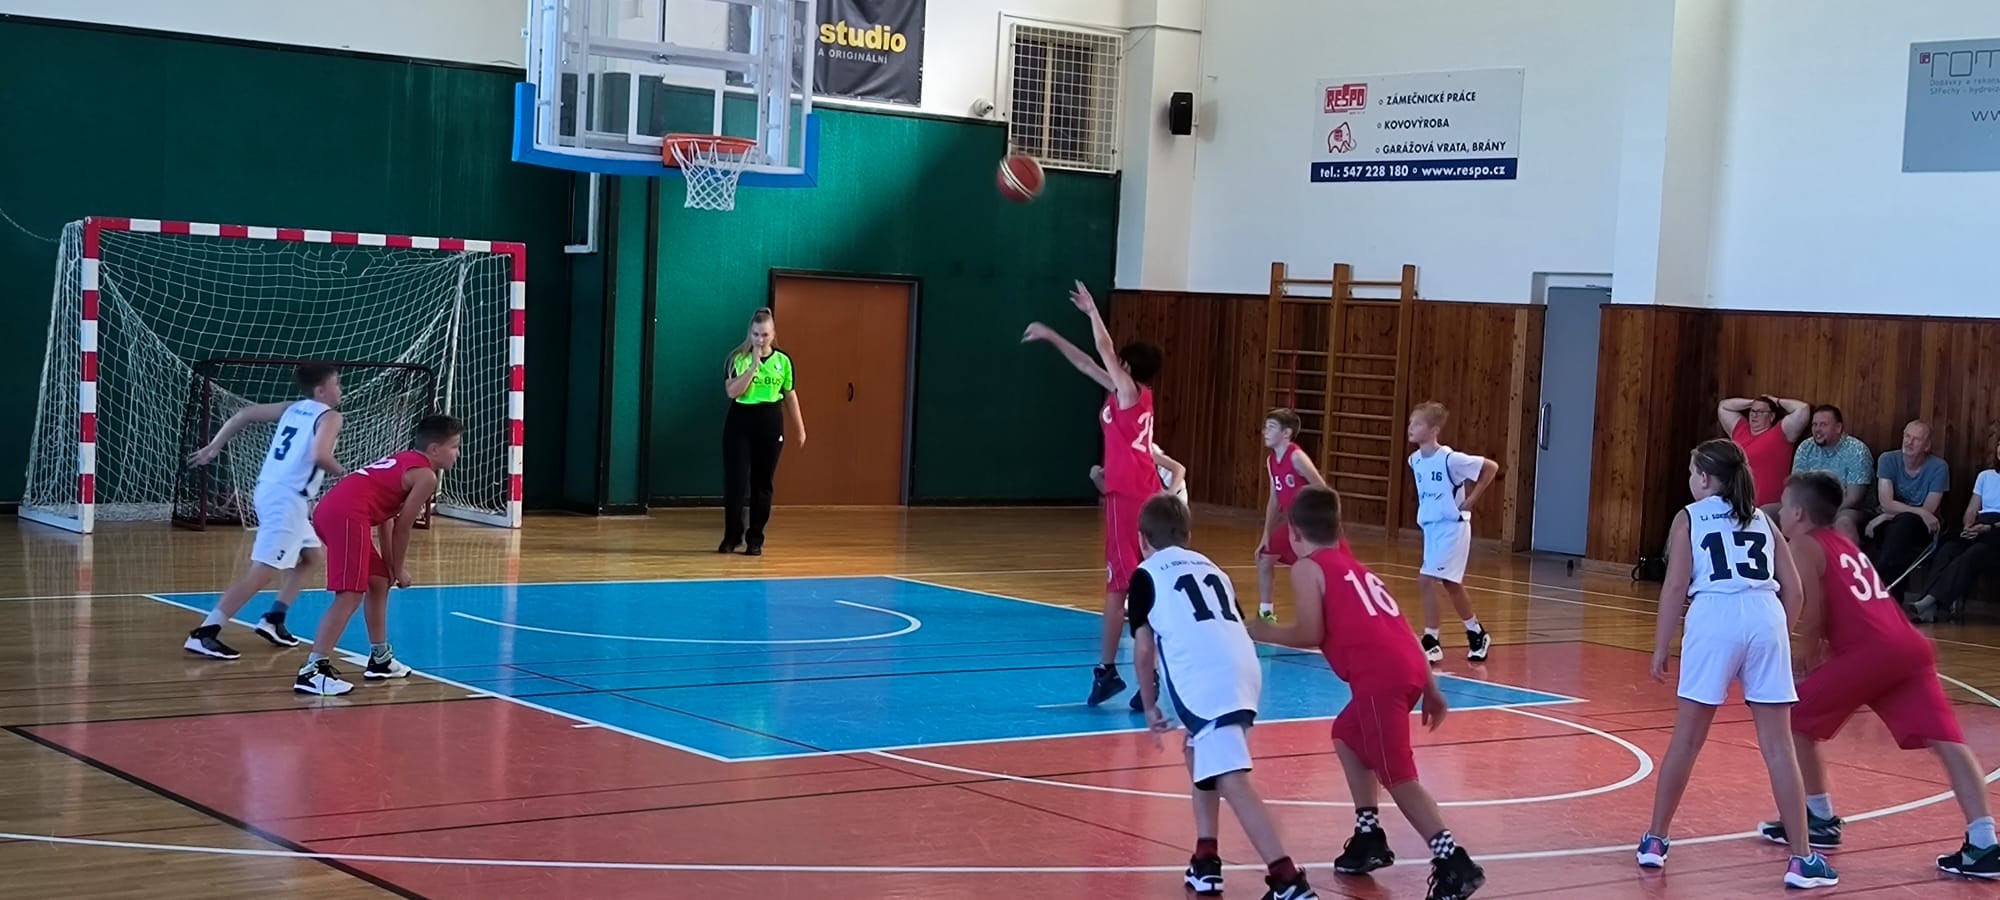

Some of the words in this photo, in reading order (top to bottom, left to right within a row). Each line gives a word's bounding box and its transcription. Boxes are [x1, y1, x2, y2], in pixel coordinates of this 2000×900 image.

[818, 48, 825, 56] A
[828, 48, 888, 64] ORIGINÁLNÍ
[1326, 84, 1365, 112] RESPO
[1386, 91, 1444, 105] ZÁMEČNICKÉ
[1447, 90, 1476, 102] PRÁCE
[1384, 116, 1449, 129] KOVOVÝROBA
[1382, 140, 1434, 154] GARÁŽOVÁ
[1437, 142, 1469, 153] VRATA,
[1472, 139, 1506, 152] BRÁNY
[1320, 166, 1340, 178] tel.:
[1343, 166, 1361, 177] 547
[1365, 166, 1385, 177] 228
[1389, 165, 1408, 177] 180
[1422, 166, 1505, 178] www.respo.cz
[275, 425, 298, 461] 3
[1431, 471, 1443, 481] 16
[1701, 531, 1771, 582] 13
[1840, 552, 1889, 601] 32
[1173, 573, 1239, 623] 11
[1344, 569, 1400, 617] 16
